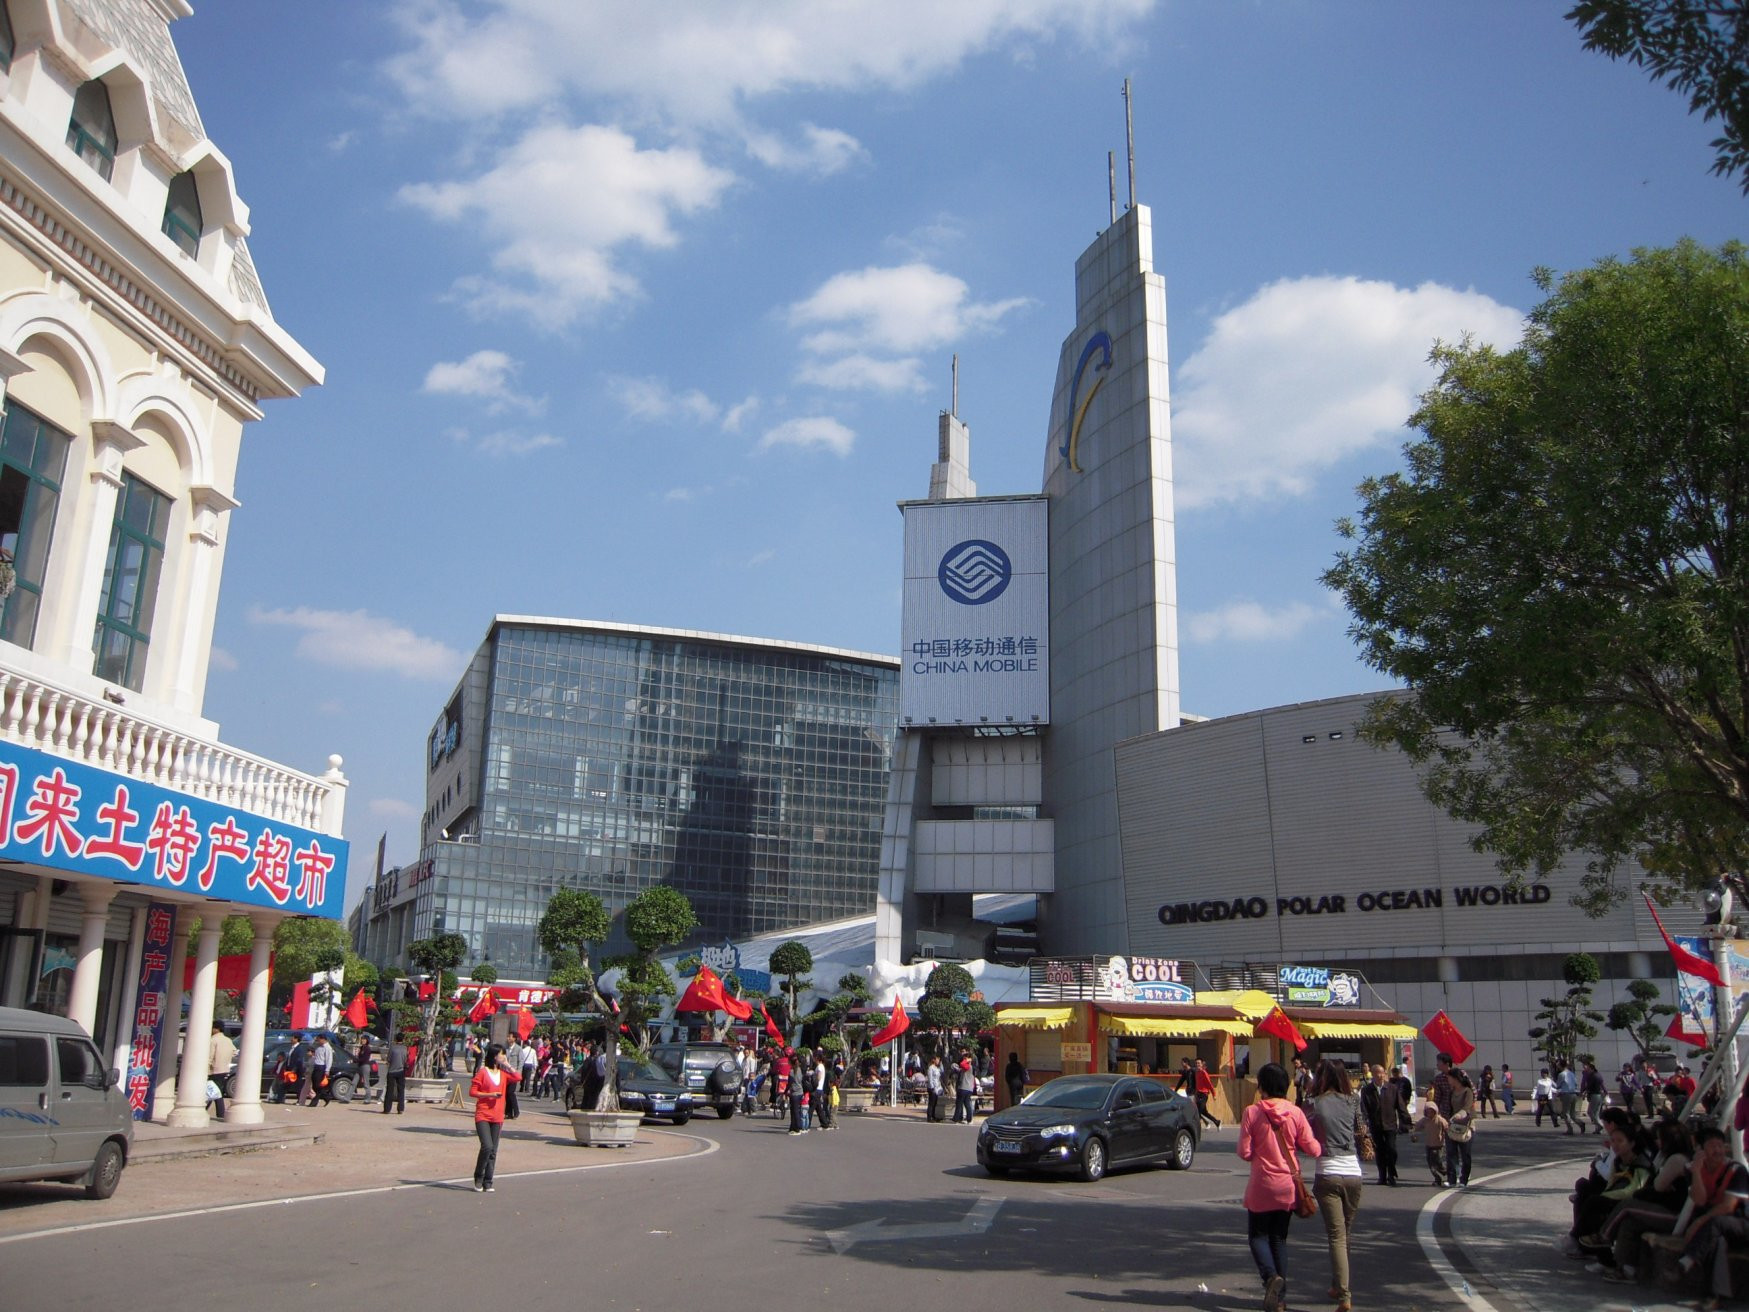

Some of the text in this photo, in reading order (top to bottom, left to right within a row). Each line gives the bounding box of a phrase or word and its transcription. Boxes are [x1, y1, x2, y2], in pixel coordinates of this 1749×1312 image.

[913, 636, 1038, 659] 中国移动通信
[913, 658, 1038, 675] CHINA MOBILE
[1158, 884, 1551, 925] QINGDAO POLAR OCEAN WORLD
[1132, 956, 1179, 966] Drink Zone
[1132, 964, 1181, 981] COOL
[1280, 967, 1327, 988] Magic
[129, 909, 171, 1111] 海产品批发
